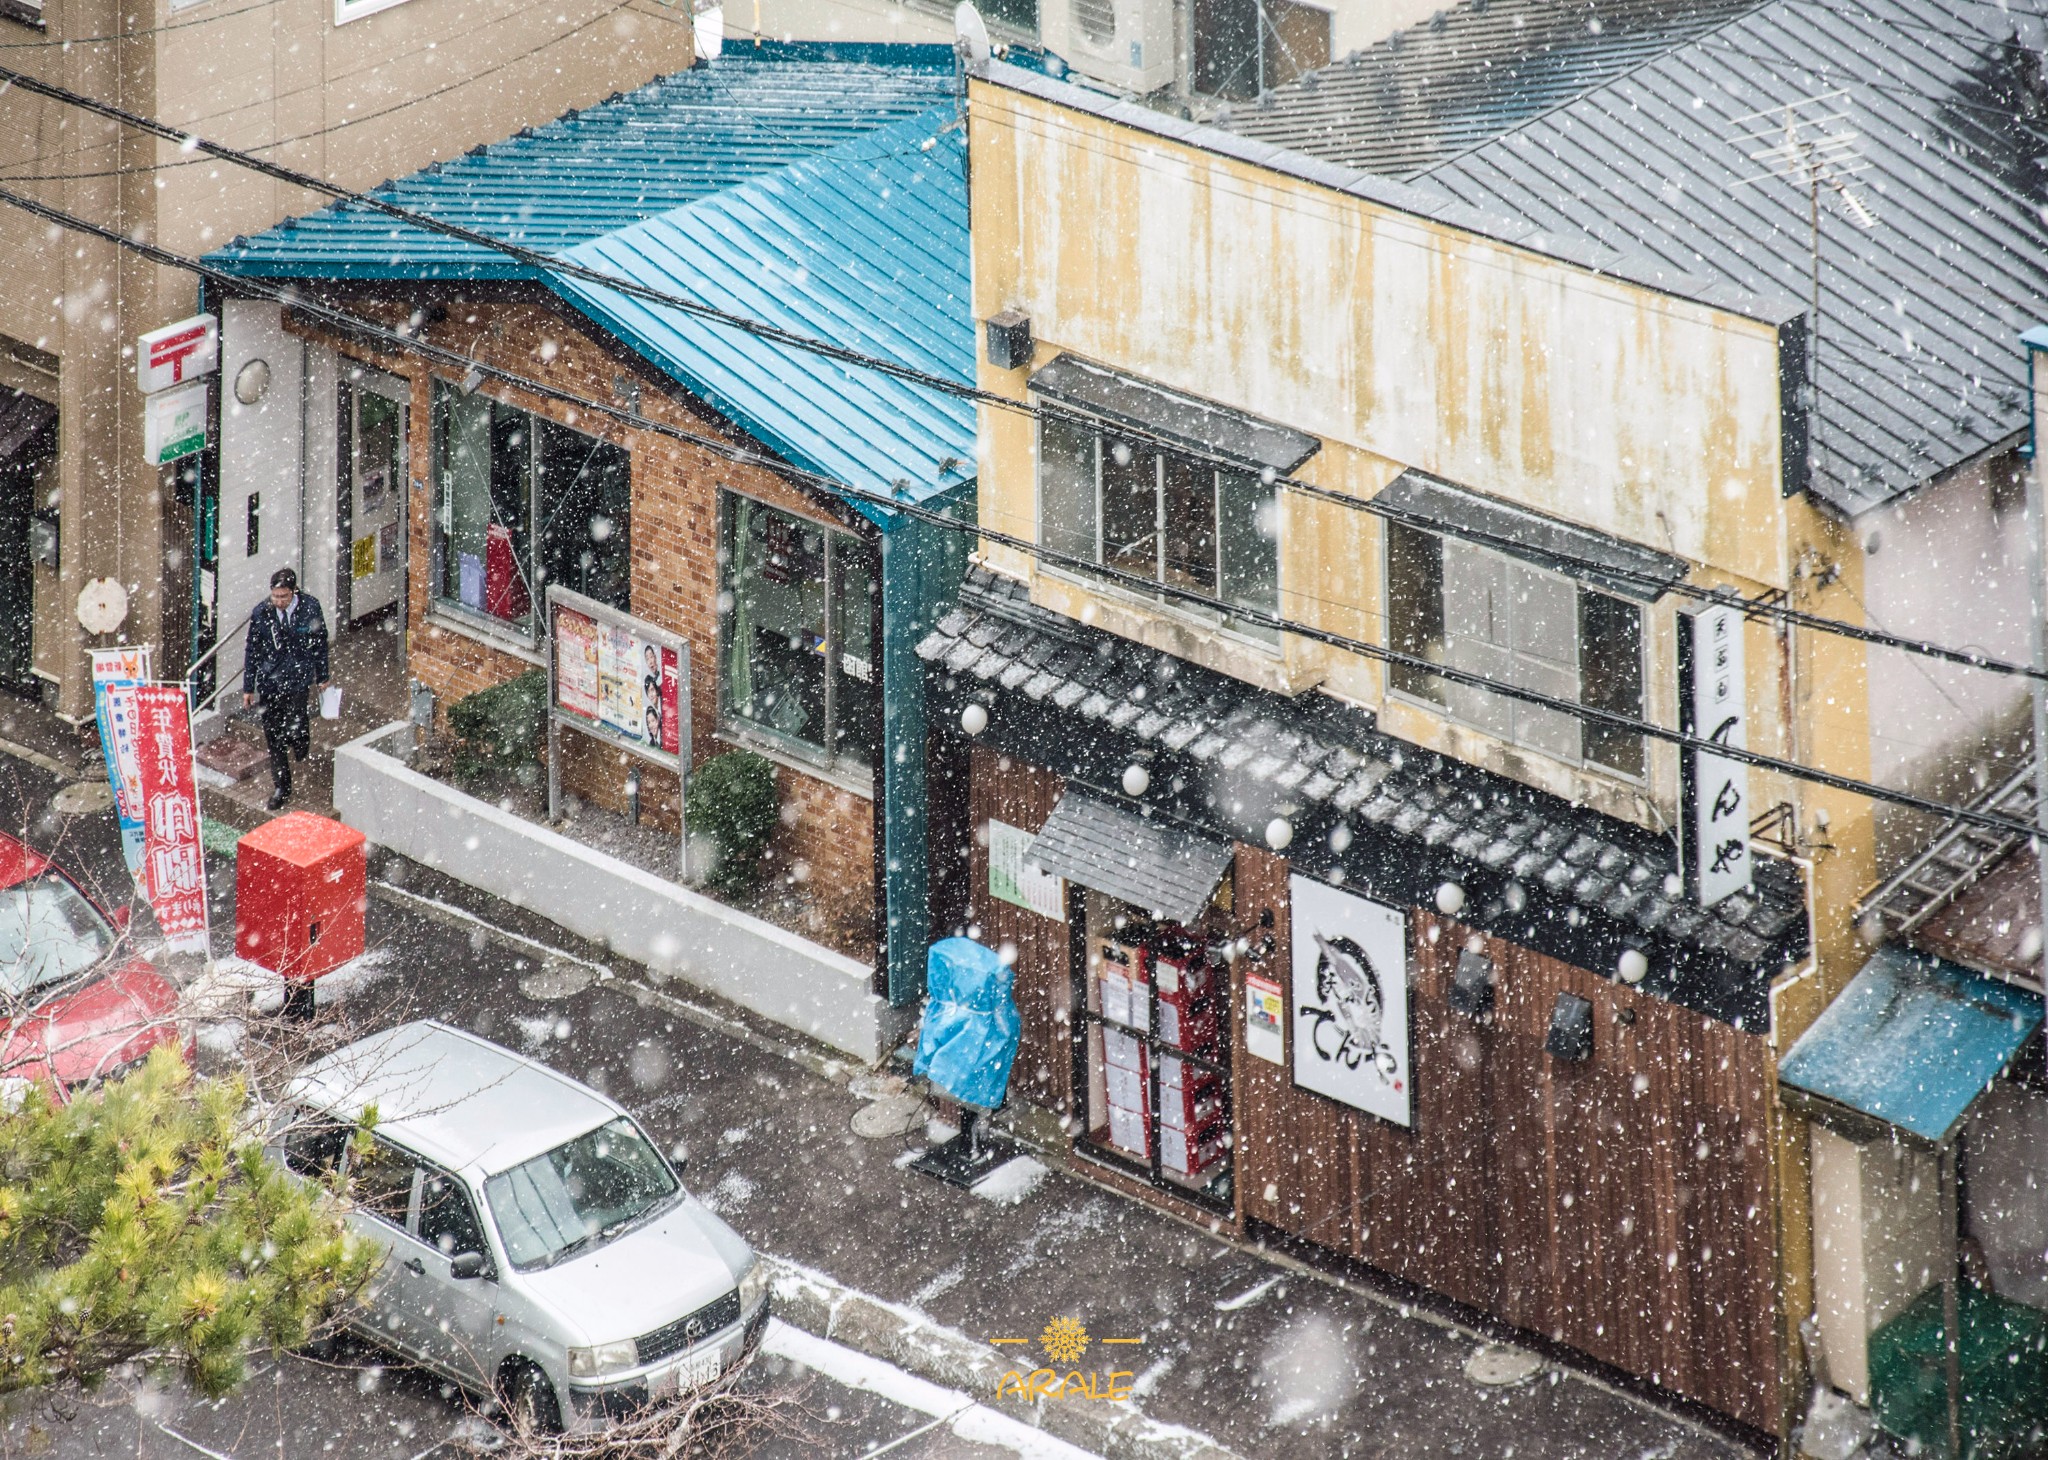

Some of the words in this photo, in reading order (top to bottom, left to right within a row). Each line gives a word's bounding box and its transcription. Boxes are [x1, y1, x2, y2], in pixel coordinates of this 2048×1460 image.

[1710, 715, 1744, 875] てんや
[1300, 1004, 1398, 1086] てんや
